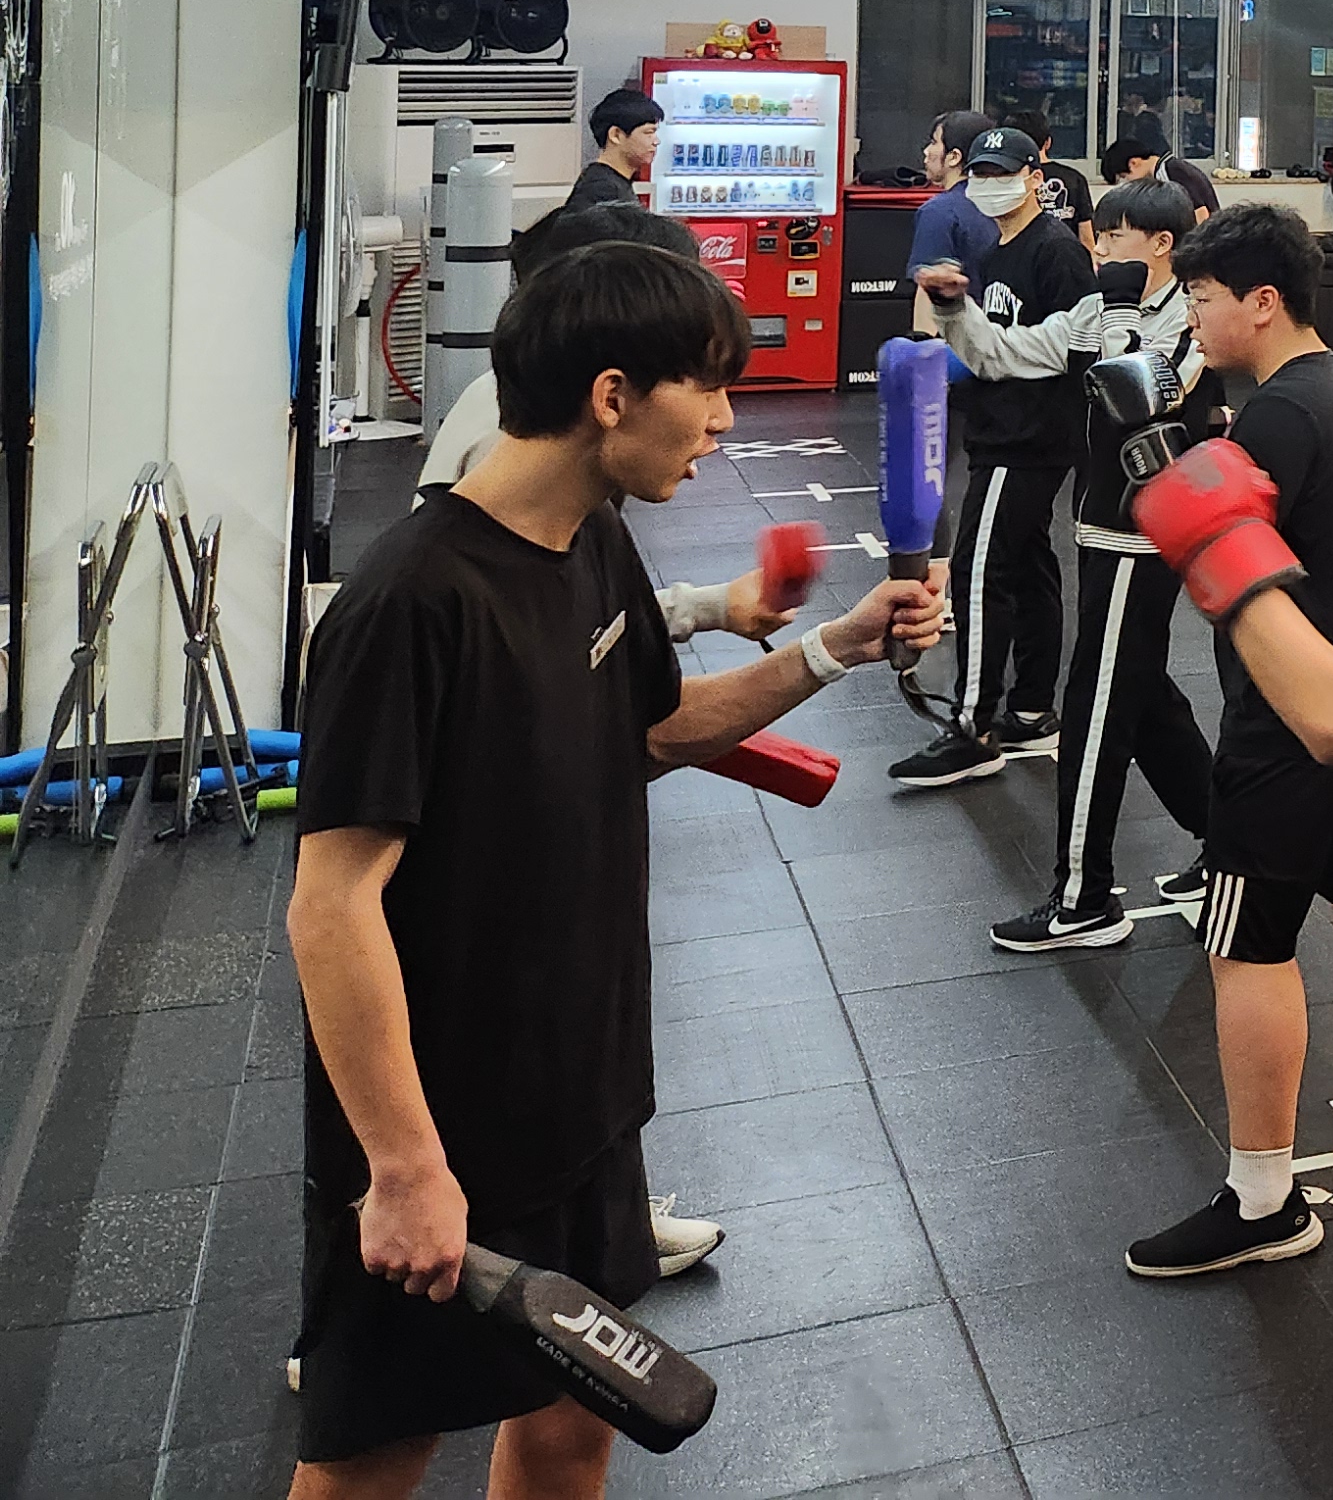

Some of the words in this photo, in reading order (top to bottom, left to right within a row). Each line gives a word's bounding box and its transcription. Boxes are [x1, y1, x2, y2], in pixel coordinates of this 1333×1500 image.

[984, 132, 1004, 148] NY
[699, 236, 738, 259] Cola
[851, 280, 897, 293] METCON
